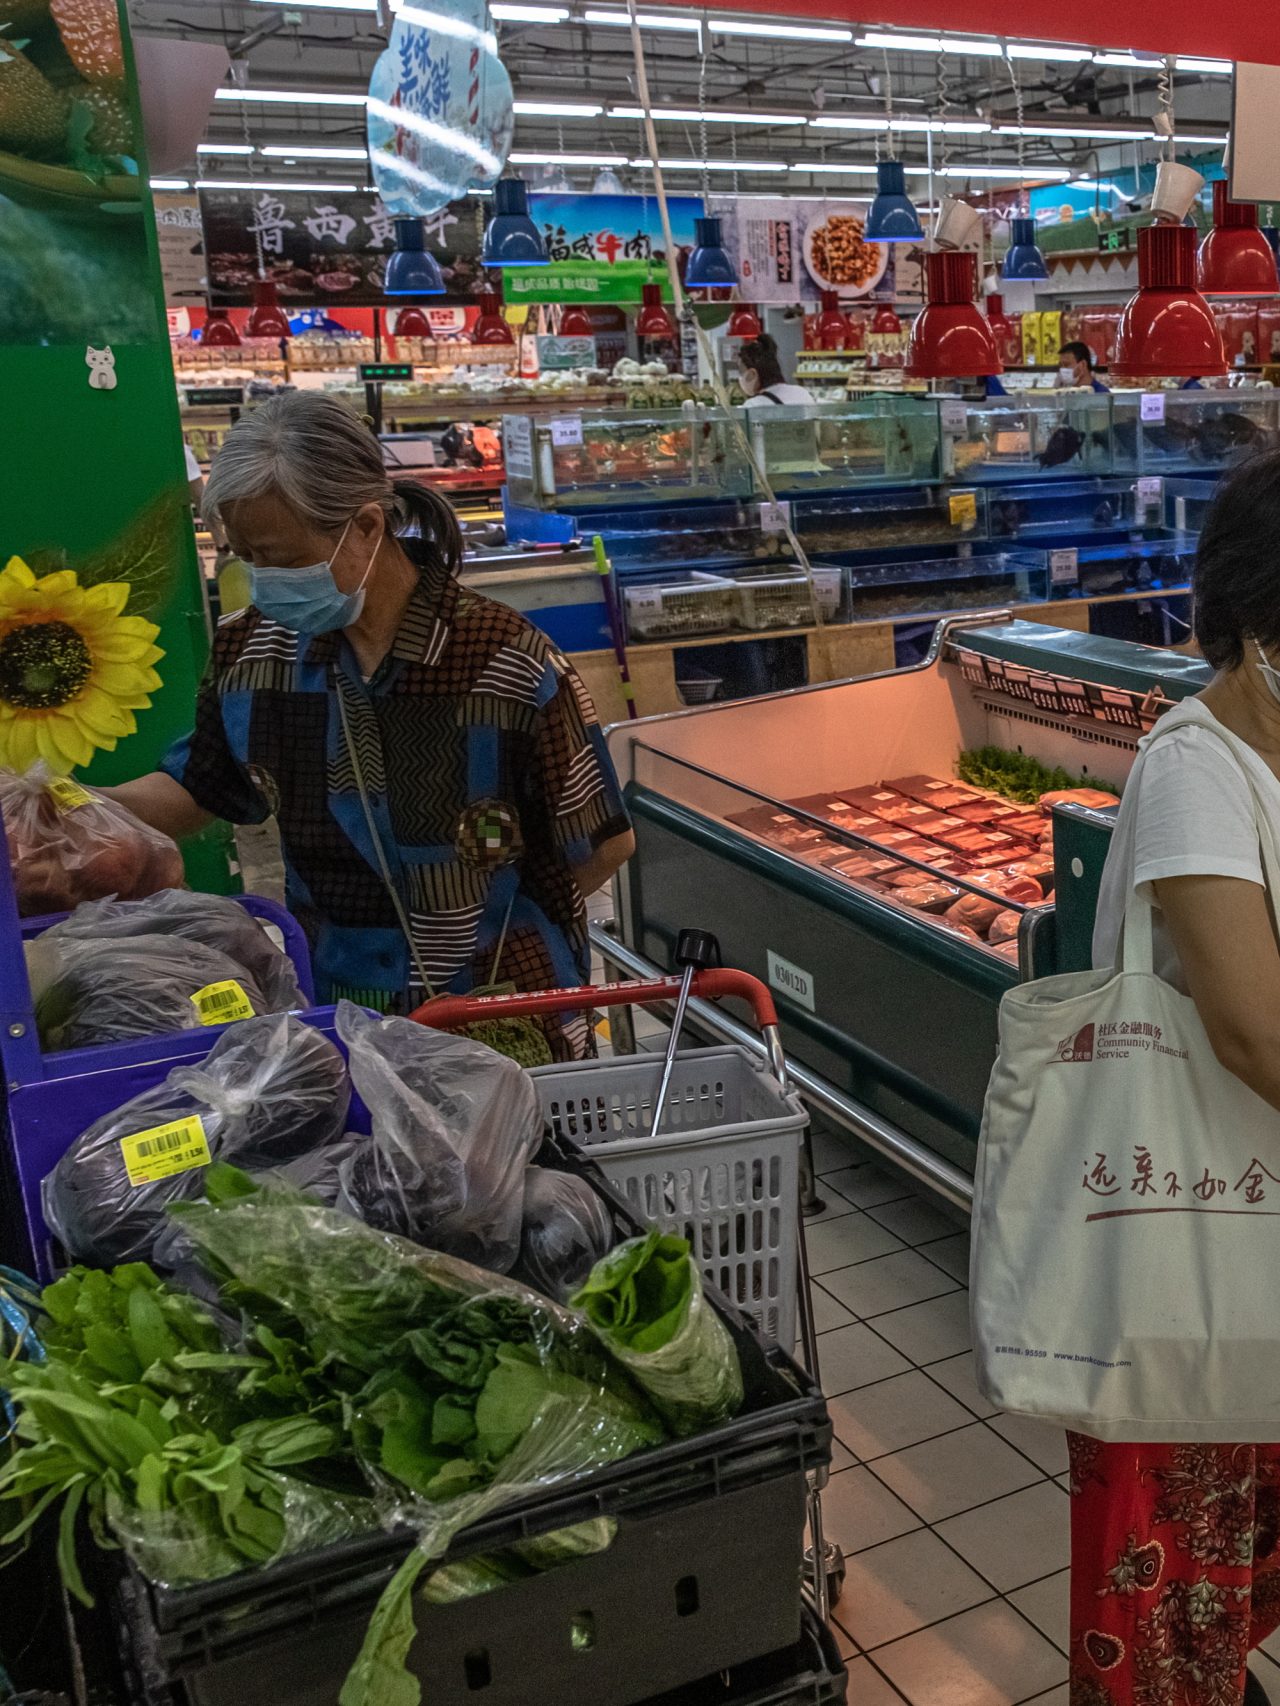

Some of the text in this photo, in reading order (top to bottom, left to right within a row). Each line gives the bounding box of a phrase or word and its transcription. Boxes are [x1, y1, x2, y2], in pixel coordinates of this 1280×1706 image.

[774, 963, 808, 996] 03012D
[1098, 1021, 1163, 1040] 社区金融服务
[1096, 1049, 1130, 1060] Service
[1097, 1037, 1190, 1060] Community Financial
